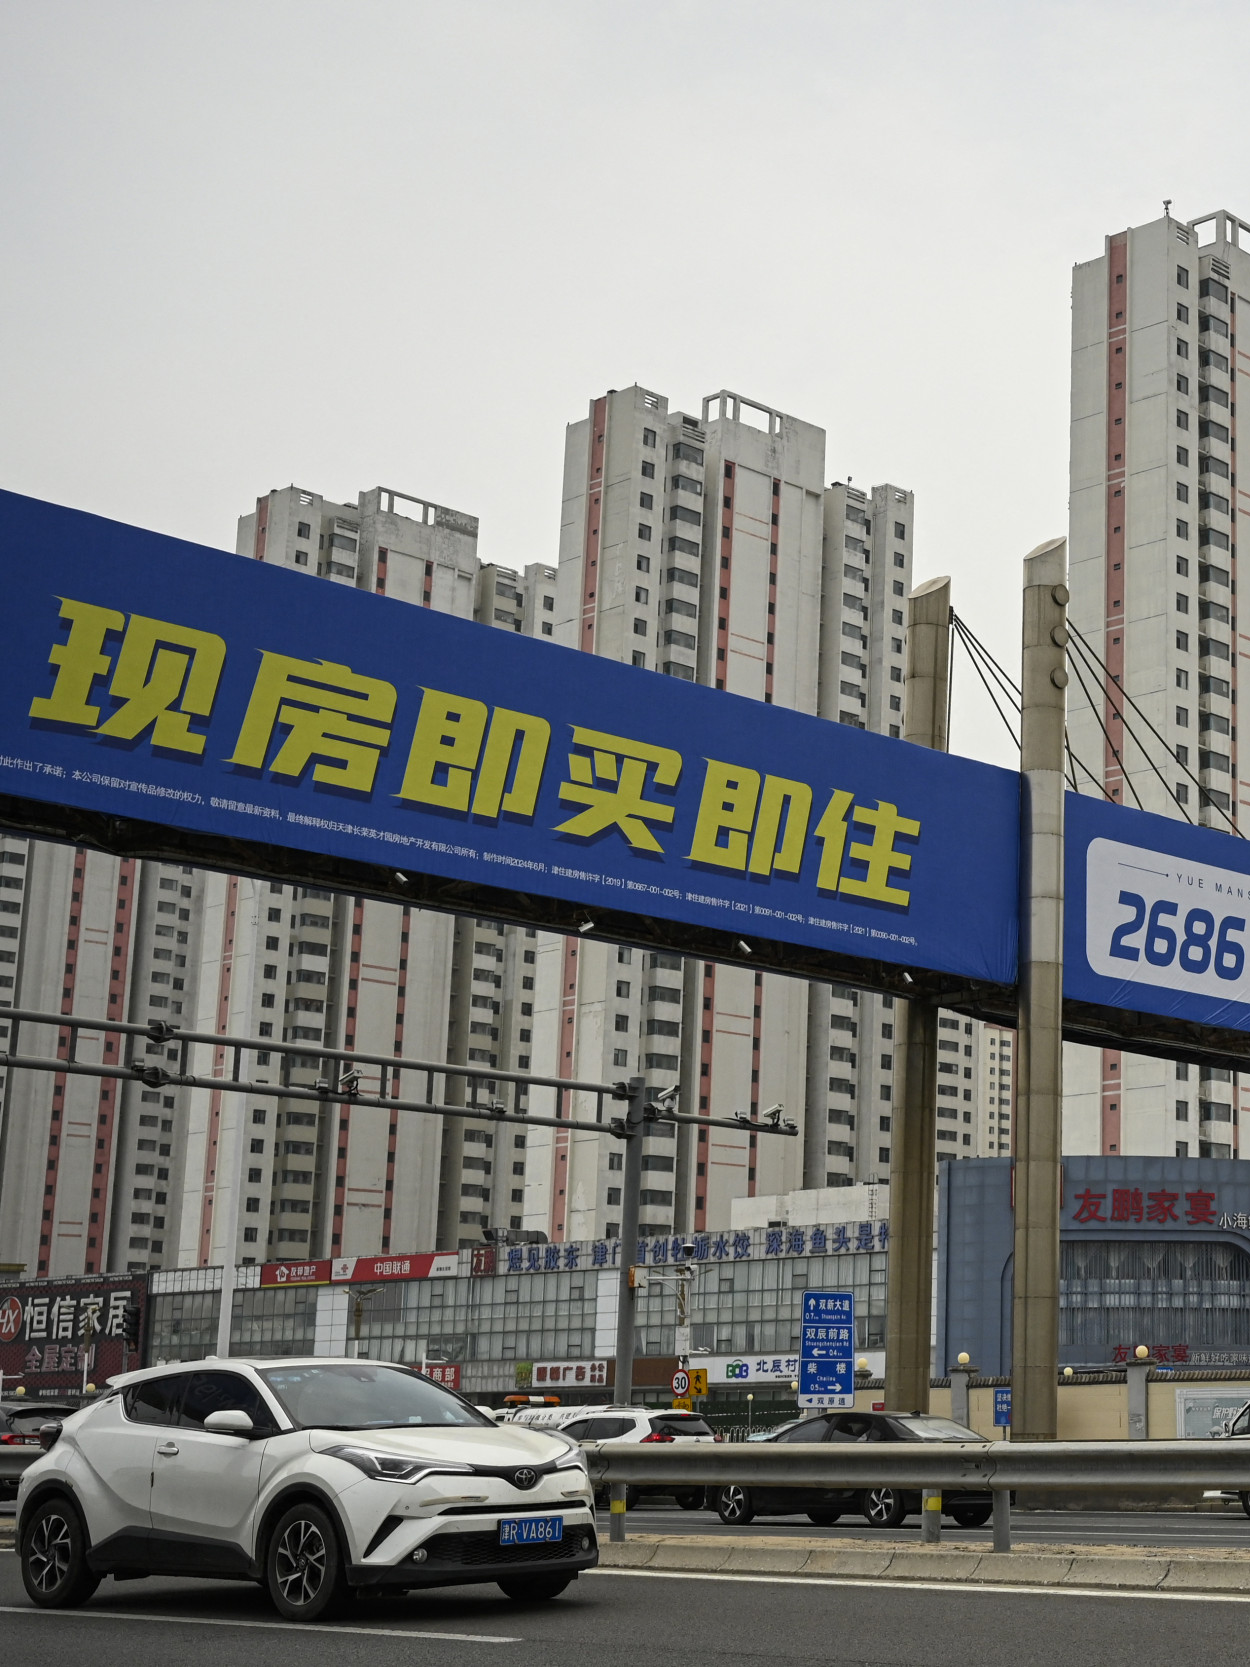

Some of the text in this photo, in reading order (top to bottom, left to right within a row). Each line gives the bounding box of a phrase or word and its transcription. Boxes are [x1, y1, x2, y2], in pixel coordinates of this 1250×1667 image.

[28, 595, 921, 908] 现房即买即住
[1176, 873, 1204, 888] YUE
[1109, 889, 1246, 981] 2686
[1073, 1187, 1217, 1225] 友鹏家宴
[374, 1260, 410, 1275] 中国联通
[24, 1290, 131, 1340] 恒信家居
[819, 1299, 850, 1311] 双新大道
[805, 1328, 849, 1340] 双辰前路
[25, 1344, 96, 1372] 全屋定制
[1112, 1343, 1190, 1363] 友家宴
[674, 1377, 686, 1390] 30
